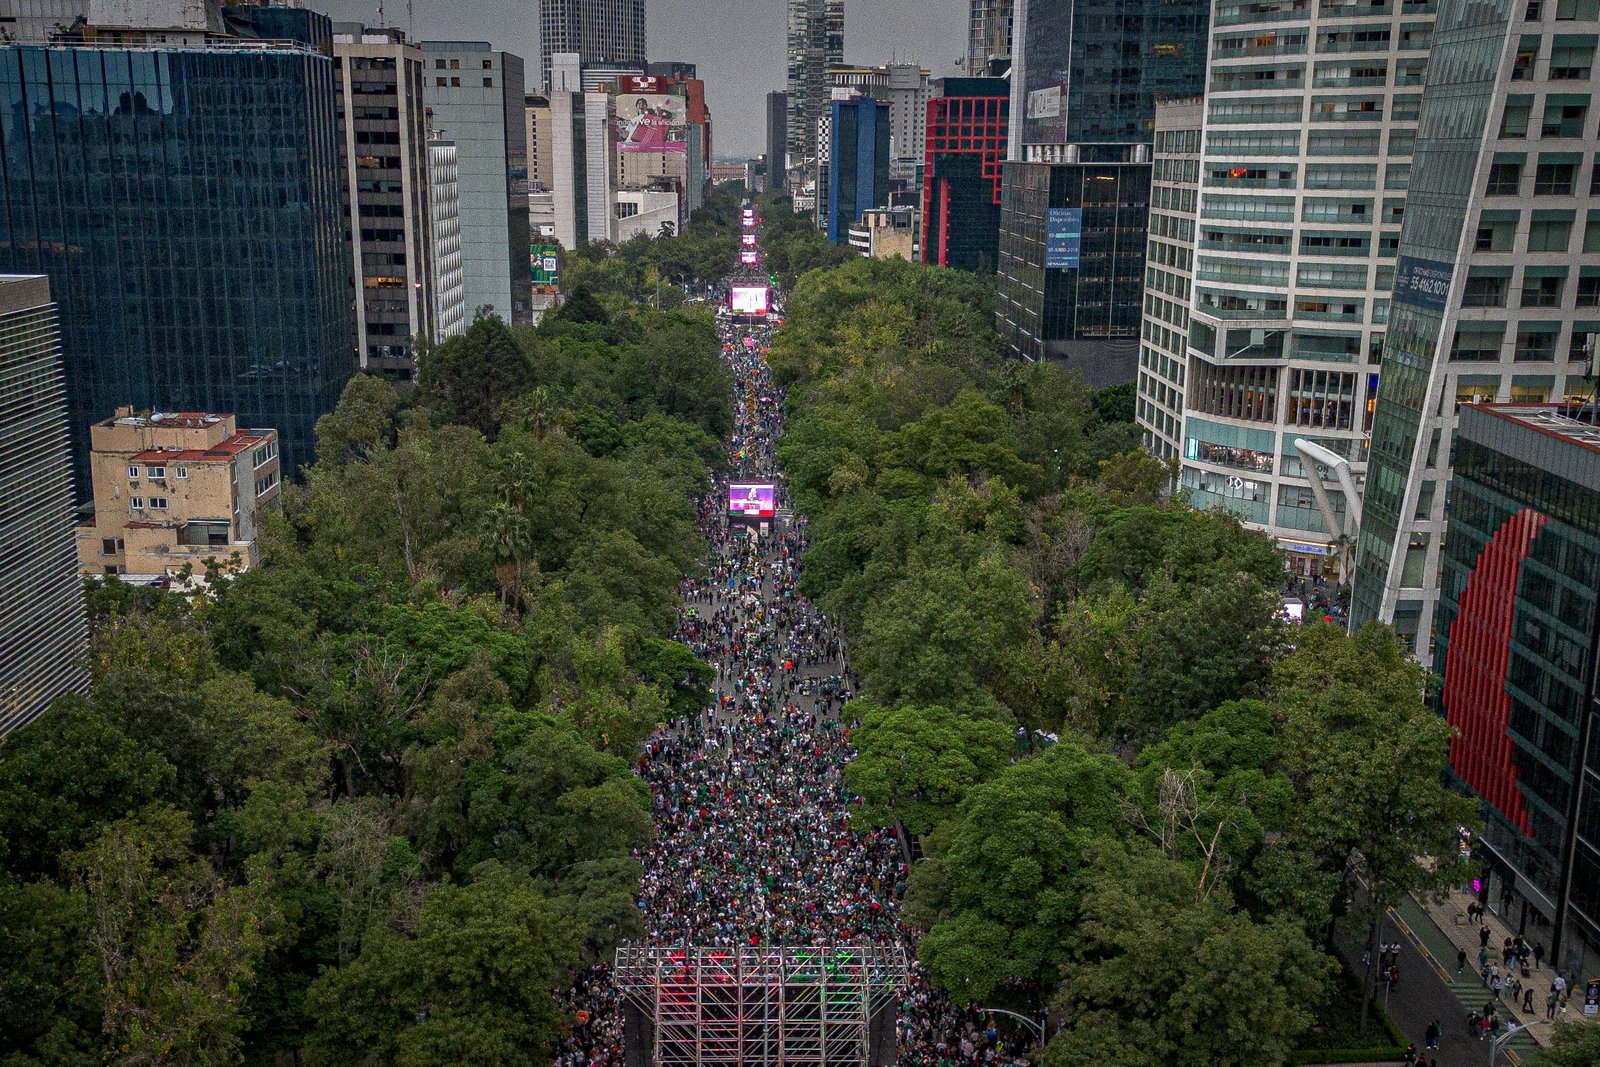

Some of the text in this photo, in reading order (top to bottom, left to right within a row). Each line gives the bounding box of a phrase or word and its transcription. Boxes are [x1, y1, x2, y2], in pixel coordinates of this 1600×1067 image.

[630, 117, 651, 126] vive
[1410, 276, 1419, 290] 55
[1434, 280, 1449, 296] 1001
